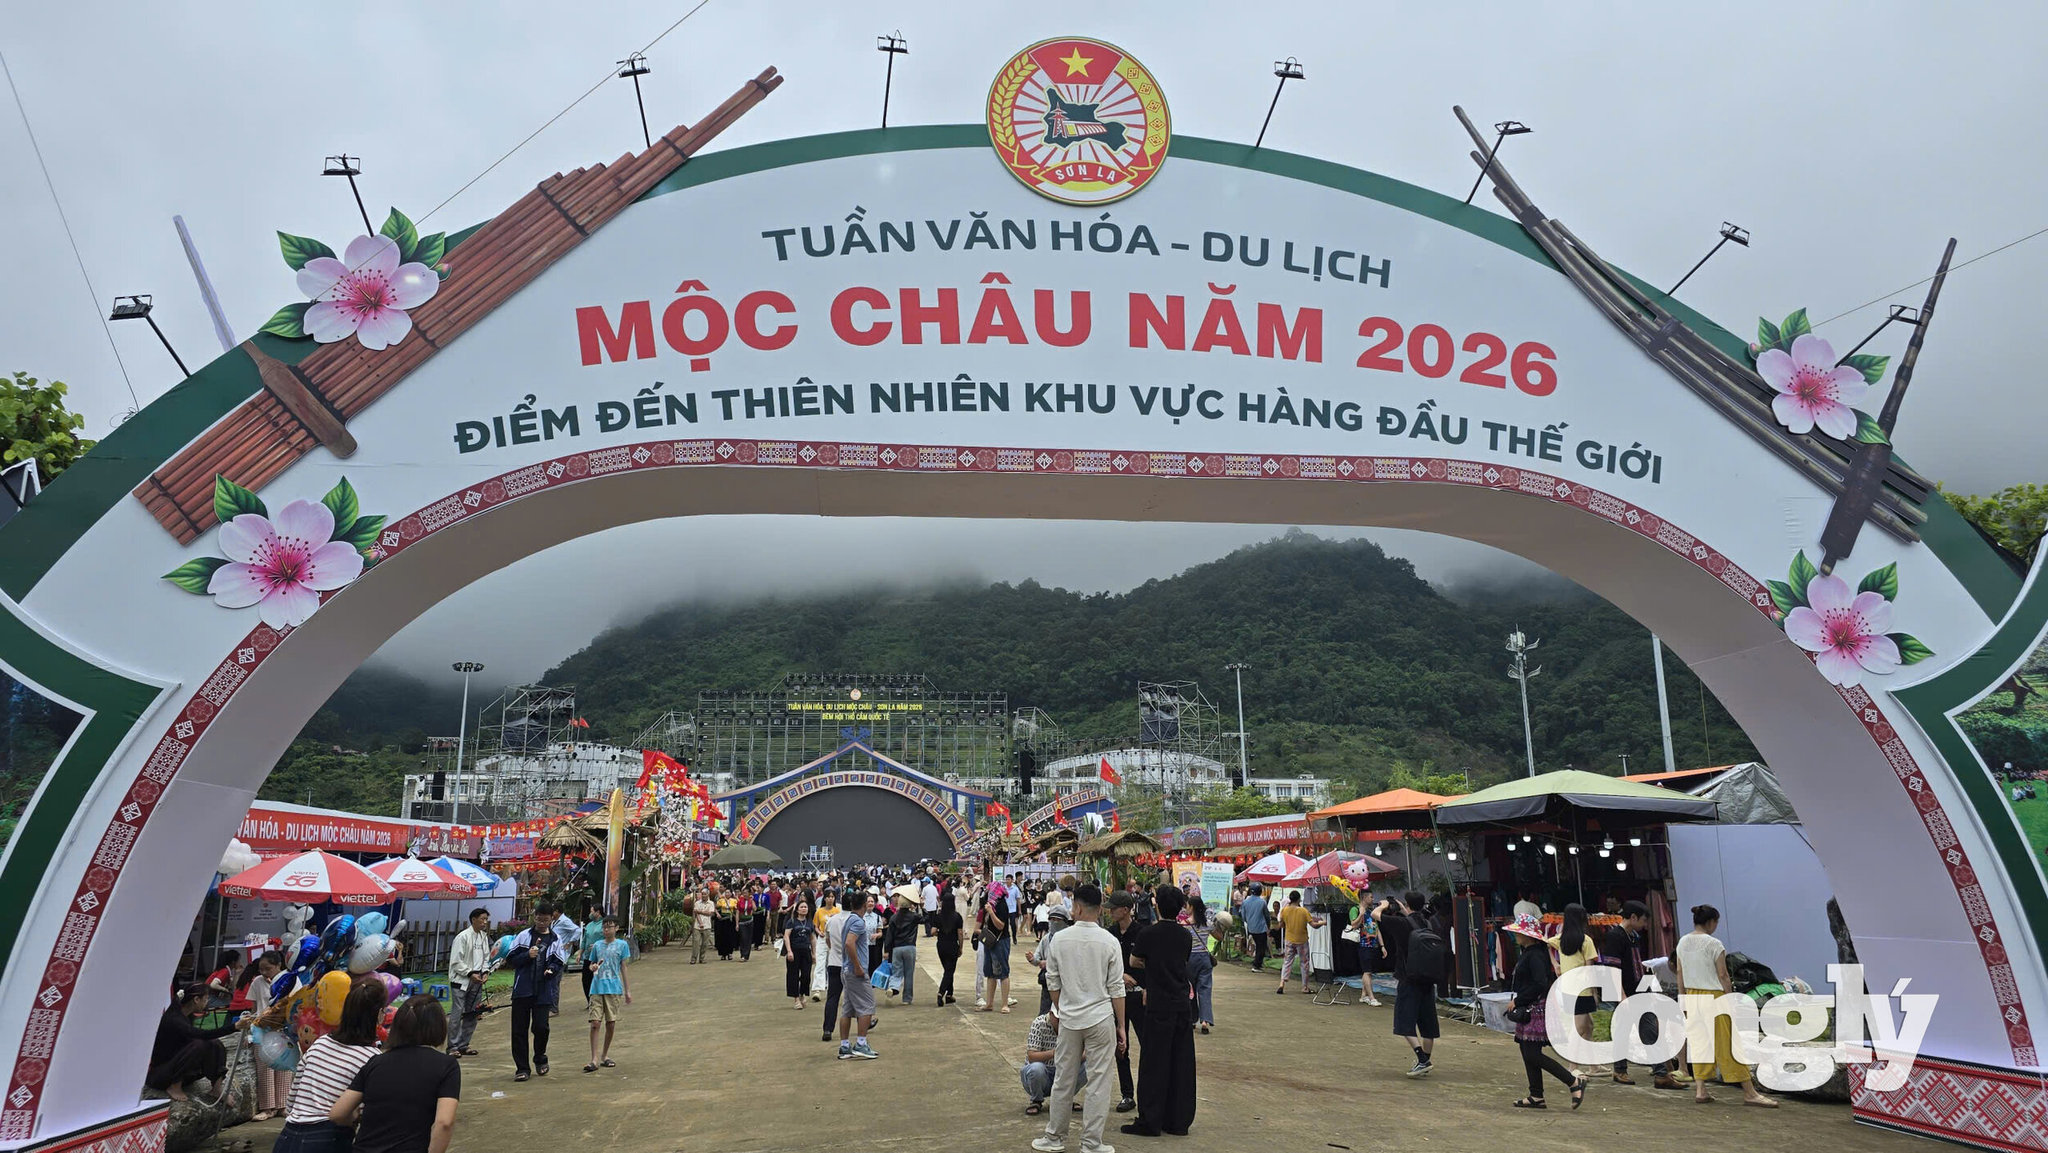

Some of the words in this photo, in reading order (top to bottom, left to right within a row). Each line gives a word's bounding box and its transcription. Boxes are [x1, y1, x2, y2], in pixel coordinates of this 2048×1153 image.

[1054, 164, 1088, 180] SƠN
[1097, 166, 1116, 182] LA
[761, 205, 916, 262] TUẦN
[924, 211, 1037, 251] VĂN
[1050, 211, 1161, 256] HÓA
[1202, 231, 1270, 267] DU
[1283, 241, 1391, 289] LỊCH
[576, 279, 798, 372] MỘC
[830, 272, 1091, 347] CHÂU
[1129, 282, 1322, 363] NĂM
[1357, 317, 1558, 397] 2026
[454, 393, 581, 455] ĐIỂM
[594, 381, 699, 434] ĐẾN
[711, 376, 855, 421] THIÊN
[870, 373, 1010, 414] NHIÊN
[1025, 382, 1116, 414] KHU
[1128, 383, 1225, 425] VỰC
[1238, 386, 1363, 432] HÀNG
[1376, 398, 1468, 445] ĐẦU
[1481, 421, 1569, 463] THẾ
[1575, 441, 1662, 485] GIỚI
[259, 815, 279, 840] HÓA
[286, 822, 300, 841] DU
[300, 823, 319, 847] LỊCH
[320, 821, 338, 848] MỘC
[339, 822, 360, 844] CHÂU
[360, 824, 376, 845] NĂM
[376, 830, 391, 846] 2026
[283, 875, 317, 888] 5G
[402, 873, 428, 881] 5G
[224, 884, 253, 897] viettel
[449, 882, 472, 893] viettel
[339, 893, 378, 904] viettel
